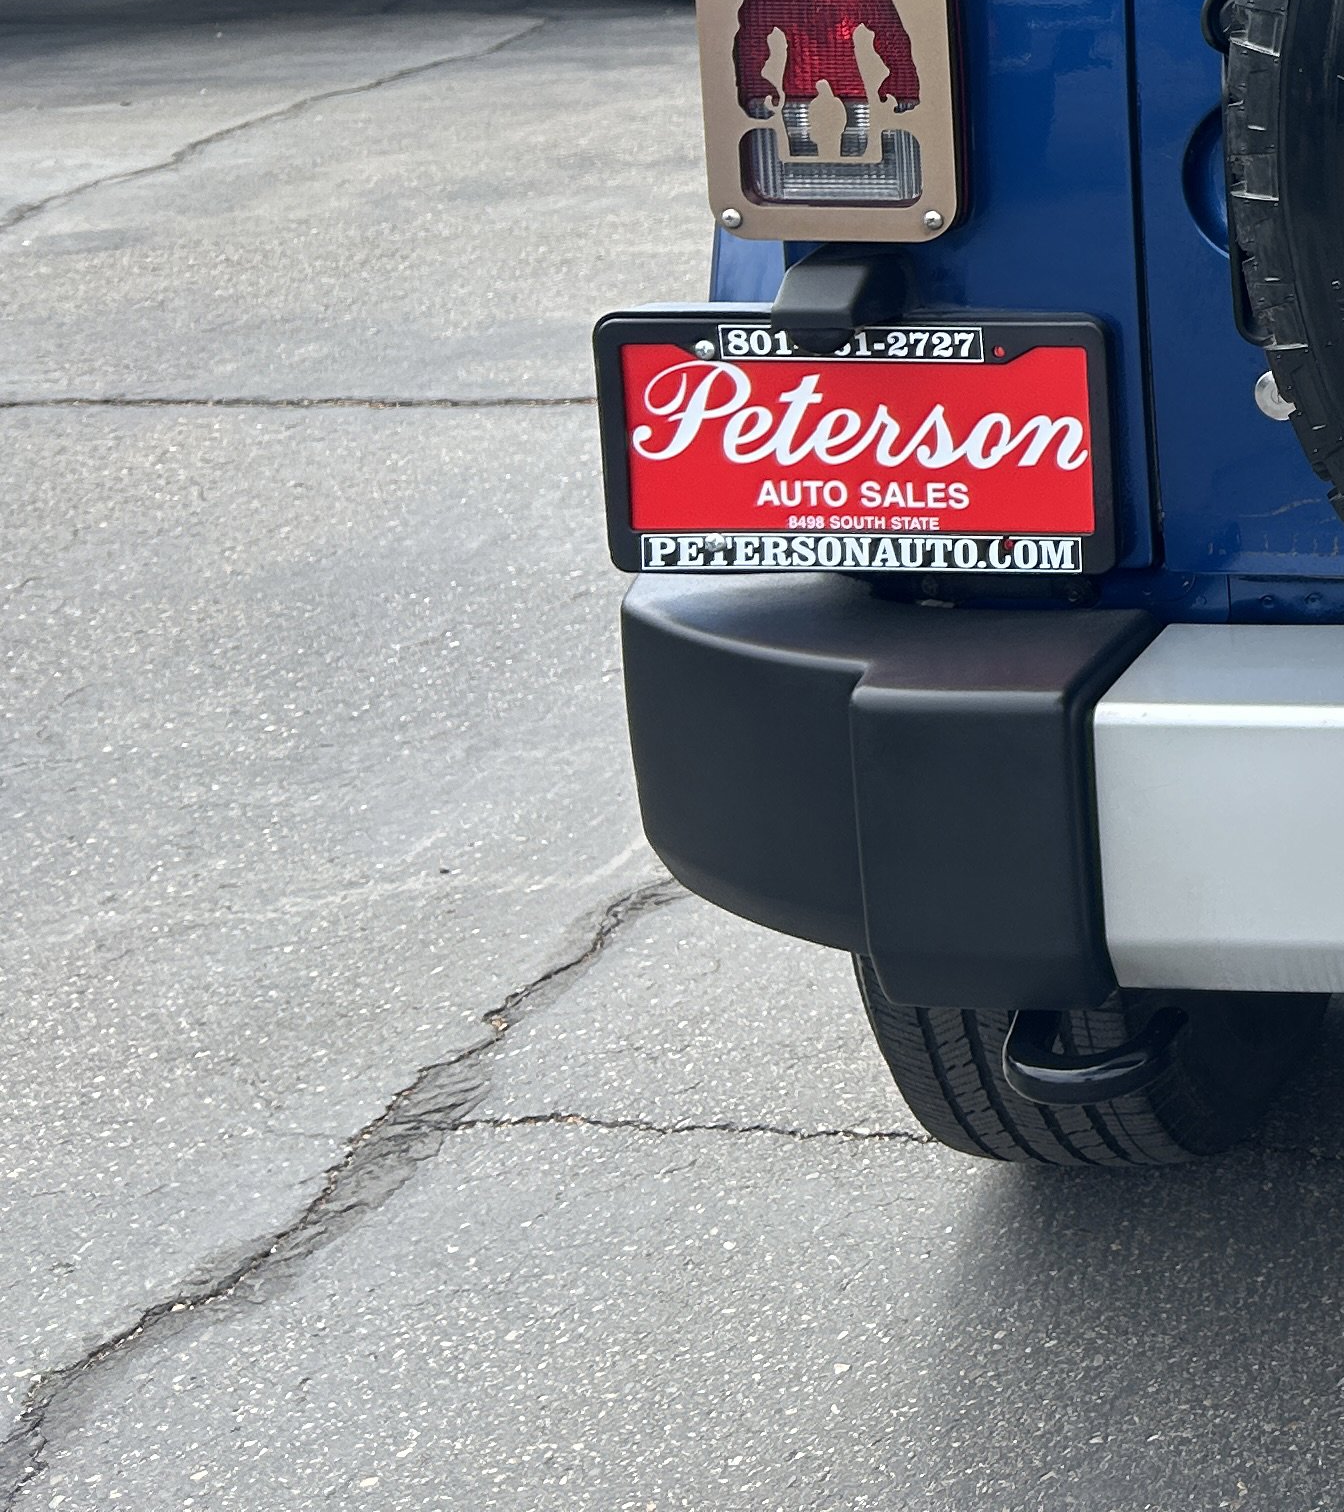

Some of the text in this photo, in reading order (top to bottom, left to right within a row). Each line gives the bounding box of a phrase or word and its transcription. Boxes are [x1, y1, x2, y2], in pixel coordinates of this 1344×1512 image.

[727, 329, 975, 358] 8011-2727
[632, 361, 1089, 471] Peterson
[757, 480, 970, 510] AUTO SALES
[788, 515, 940, 531] 8498 SOUTH STATE
